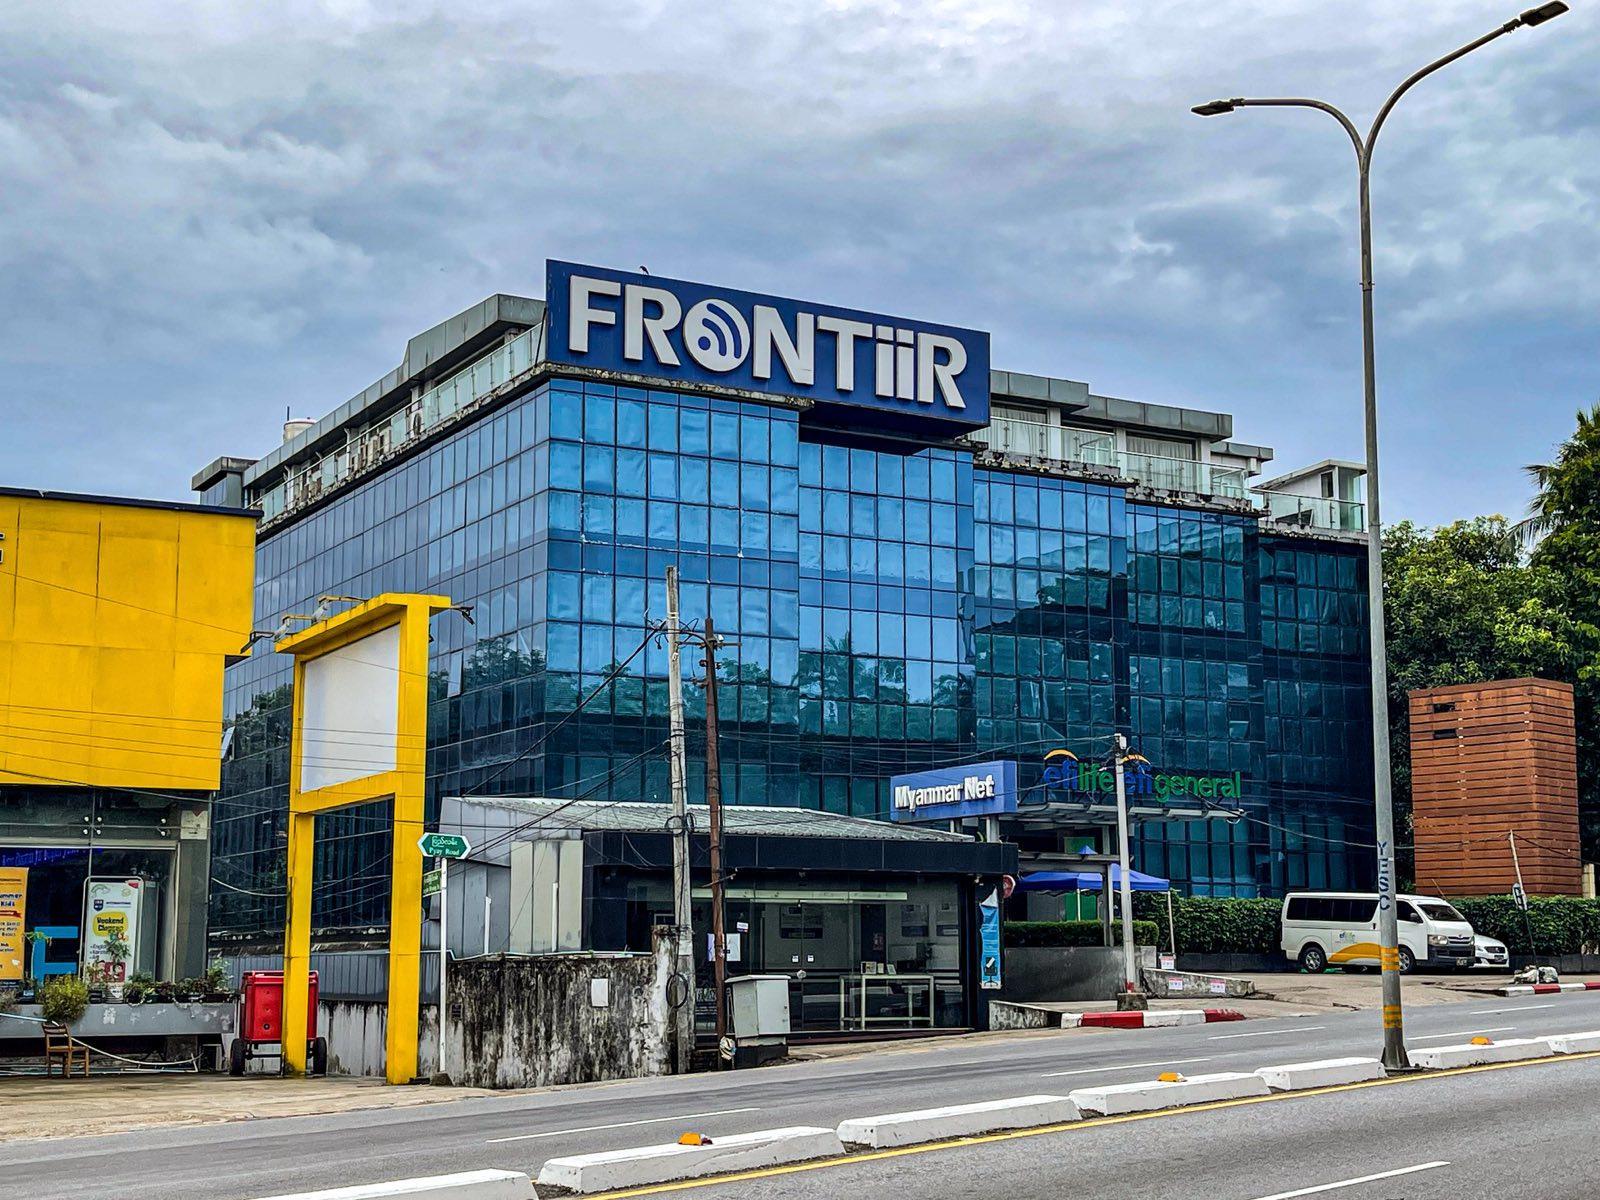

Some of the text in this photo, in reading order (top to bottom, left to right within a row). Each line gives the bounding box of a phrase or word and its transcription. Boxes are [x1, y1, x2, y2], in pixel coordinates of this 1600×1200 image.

[895, 774, 995, 812] Myanmar Net
[1377, 841, 1391, 910] YESC
